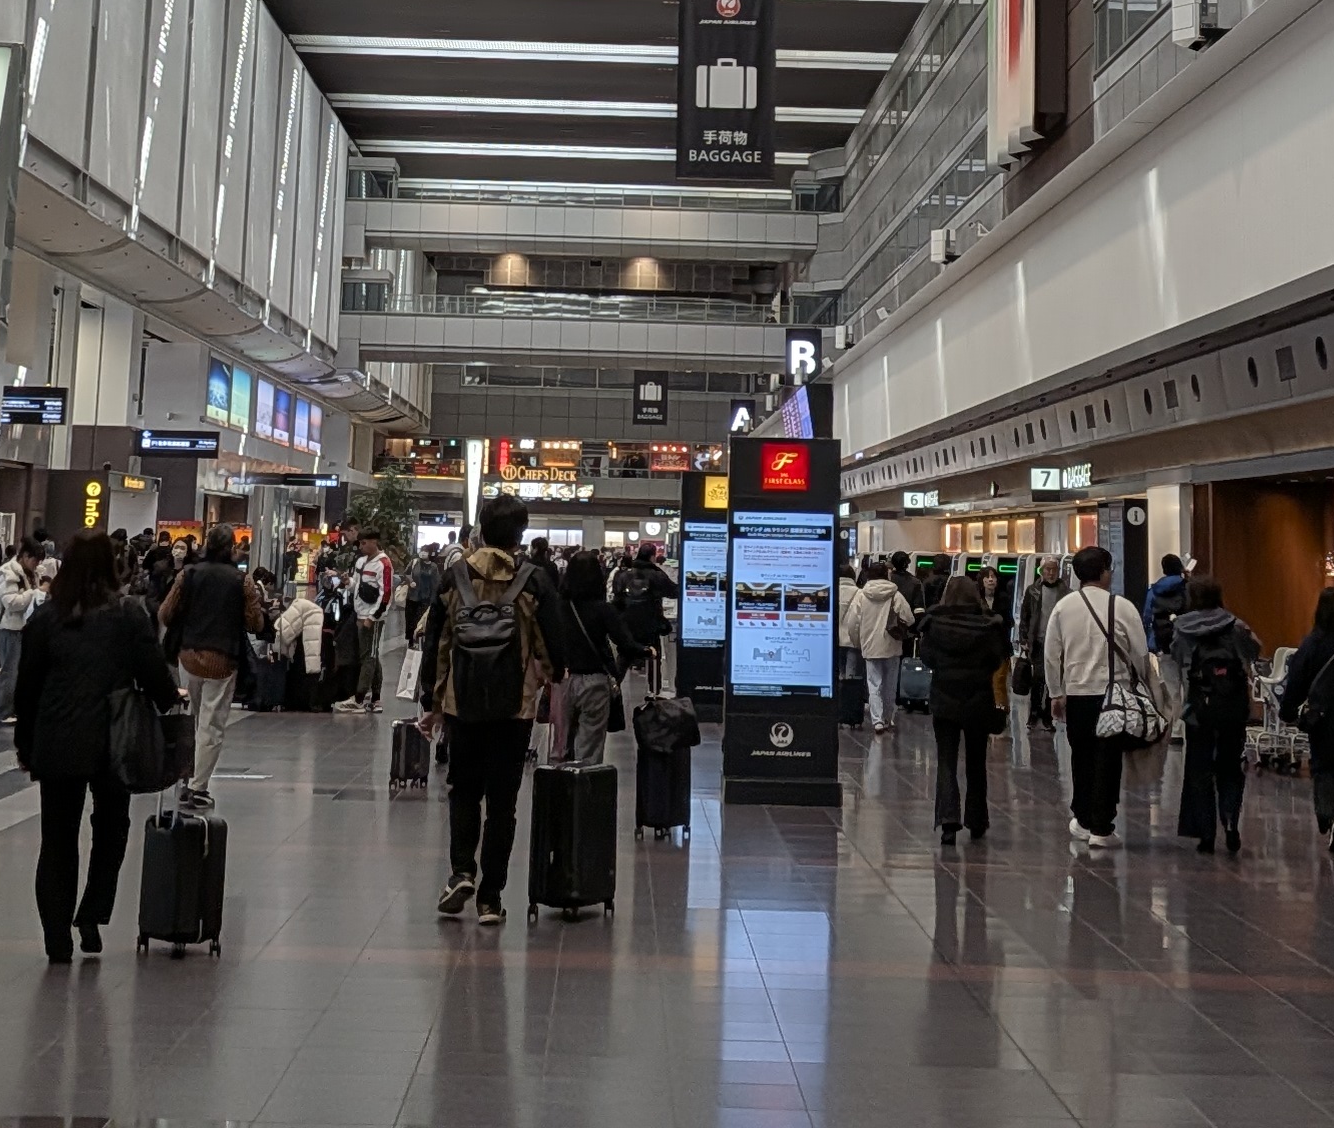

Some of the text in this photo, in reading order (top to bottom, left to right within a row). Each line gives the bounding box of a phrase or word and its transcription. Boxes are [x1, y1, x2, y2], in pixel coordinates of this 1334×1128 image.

[703, 130, 748, 146] 手荷物
[689, 149, 762, 163] BAGGAGE
[791, 340, 816, 375] B
[731, 407, 750, 432] A
[550, 467, 577, 482] DECK
[1040, 471, 1051, 487] 7
[910, 494, 919, 506] 6
[85, 499, 100, 526] Info
